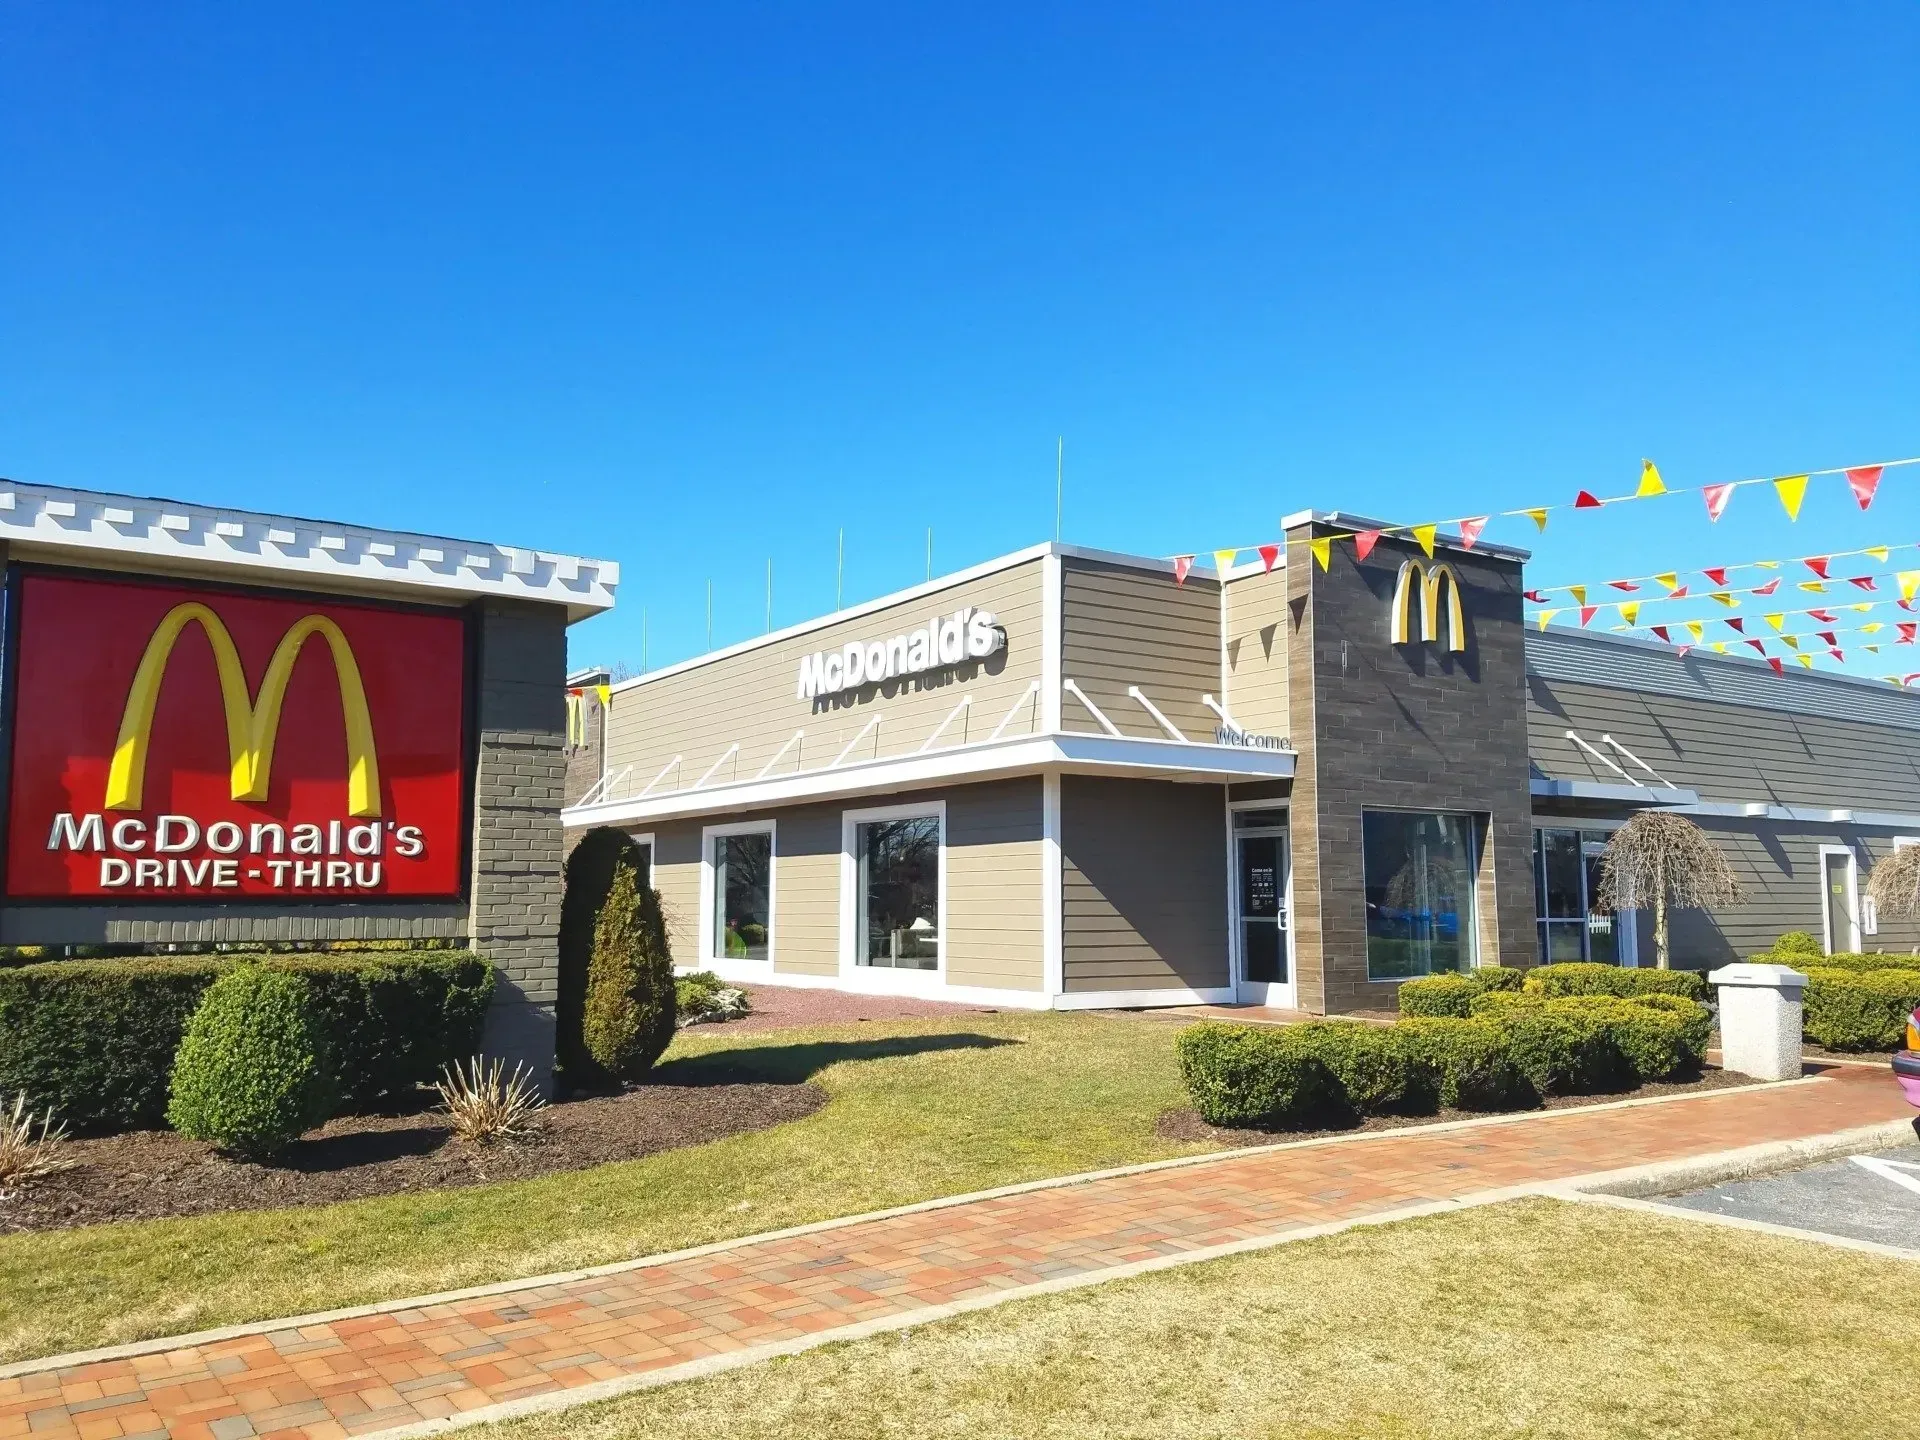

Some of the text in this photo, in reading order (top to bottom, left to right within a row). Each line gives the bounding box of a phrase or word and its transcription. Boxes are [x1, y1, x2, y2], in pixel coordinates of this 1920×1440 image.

[797, 606, 1001, 699] McDonald's
[1215, 724, 1290, 750] Welcome
[47, 813, 424, 856] McDonald's
